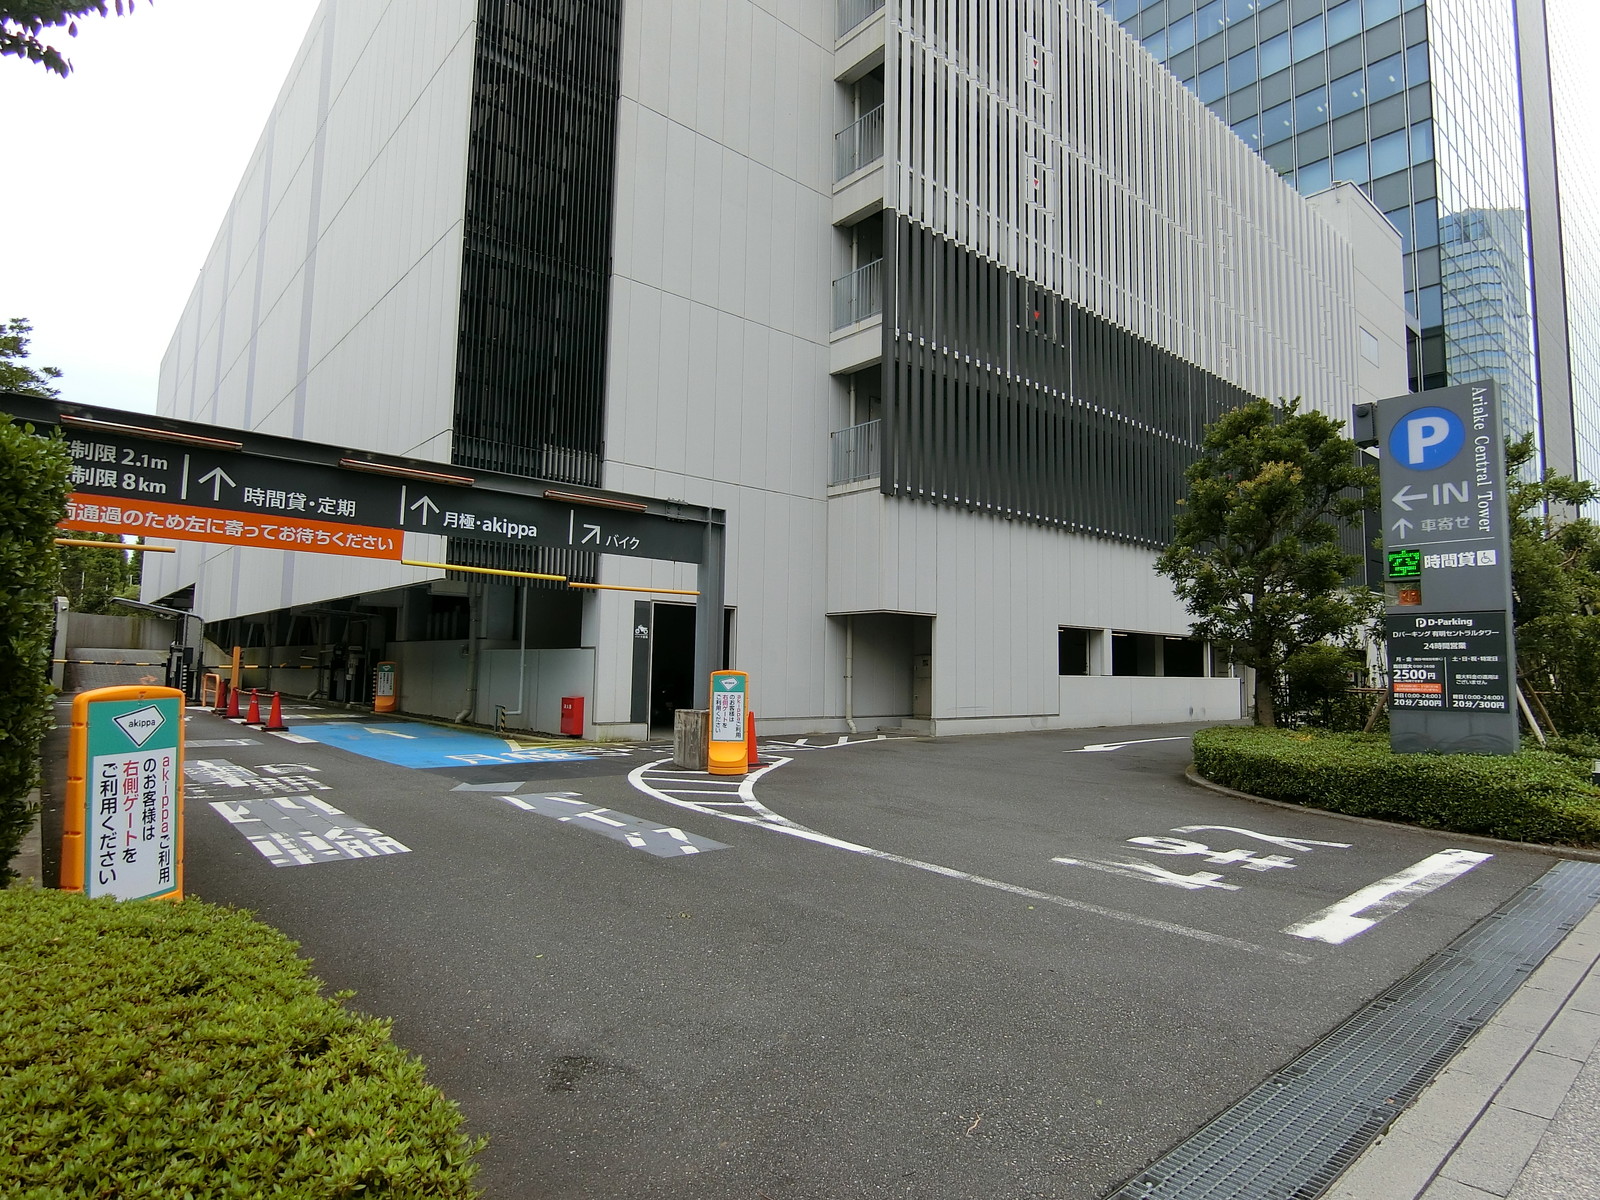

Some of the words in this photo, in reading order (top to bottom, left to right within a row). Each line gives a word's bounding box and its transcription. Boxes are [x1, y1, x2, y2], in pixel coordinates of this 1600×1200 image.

[1471, 387, 1489, 431] Ariake
[66, 440, 117, 464] 制限
[121, 448, 168, 470] 2.1m
[1407, 416, 1450, 465] P
[1474, 435, 1490, 487] Central
[66, 466, 118, 488] 制限
[243, 487, 357, 518] 時間貸・定期
[1432, 480, 1469, 506] IN
[1420, 515, 1471, 533] 車寄せ
[1477, 491, 1493, 532] Tower
[605, 534, 641, 551] バイク
[1424, 551, 1476, 569] 時間貸
[128, 718, 156, 728] akippa
[122, 760, 140, 864] 右側ゲートを
[142, 757, 157, 841] のお客様は
[98, 763, 119, 885] ご利用ください
